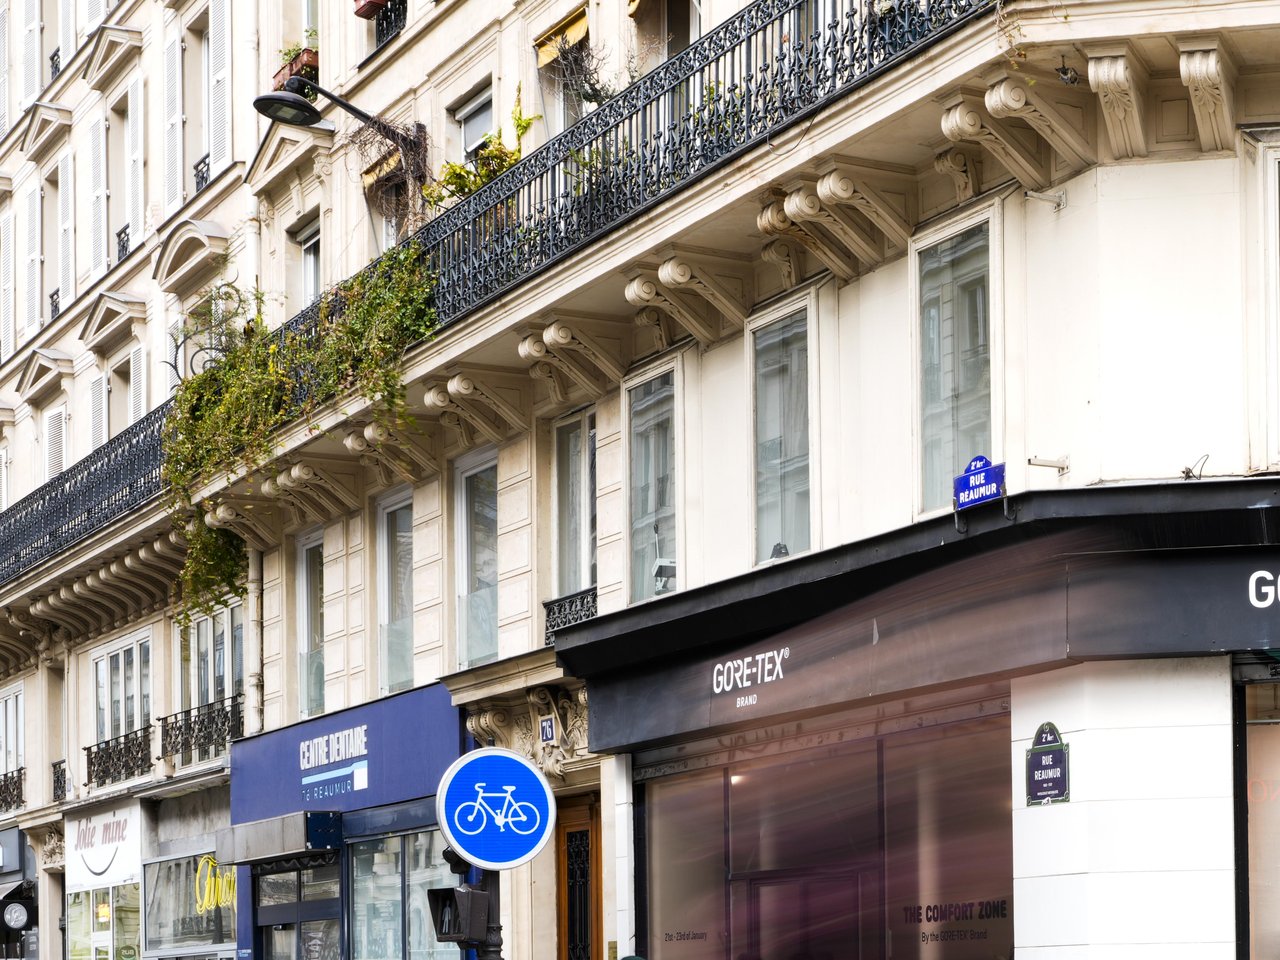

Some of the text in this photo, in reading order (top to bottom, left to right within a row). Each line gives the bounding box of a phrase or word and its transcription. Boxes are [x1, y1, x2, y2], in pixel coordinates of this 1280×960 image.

[970, 472, 986, 487] RUE
[959, 482, 997, 504] RÉAUMUR
[736, 694, 758, 708] BRAND
[542, 720, 552, 740] 76
[299, 724, 368, 771] CENTRE DENTAIRE
[1042, 754, 1053, 766] RUE
[313, 780, 352, 799] REAUMUR
[75, 810, 128, 851] Jolie mine
[903, 900, 1007, 924] THE COMFORT ZONE
[922, 931, 930, 944] By
